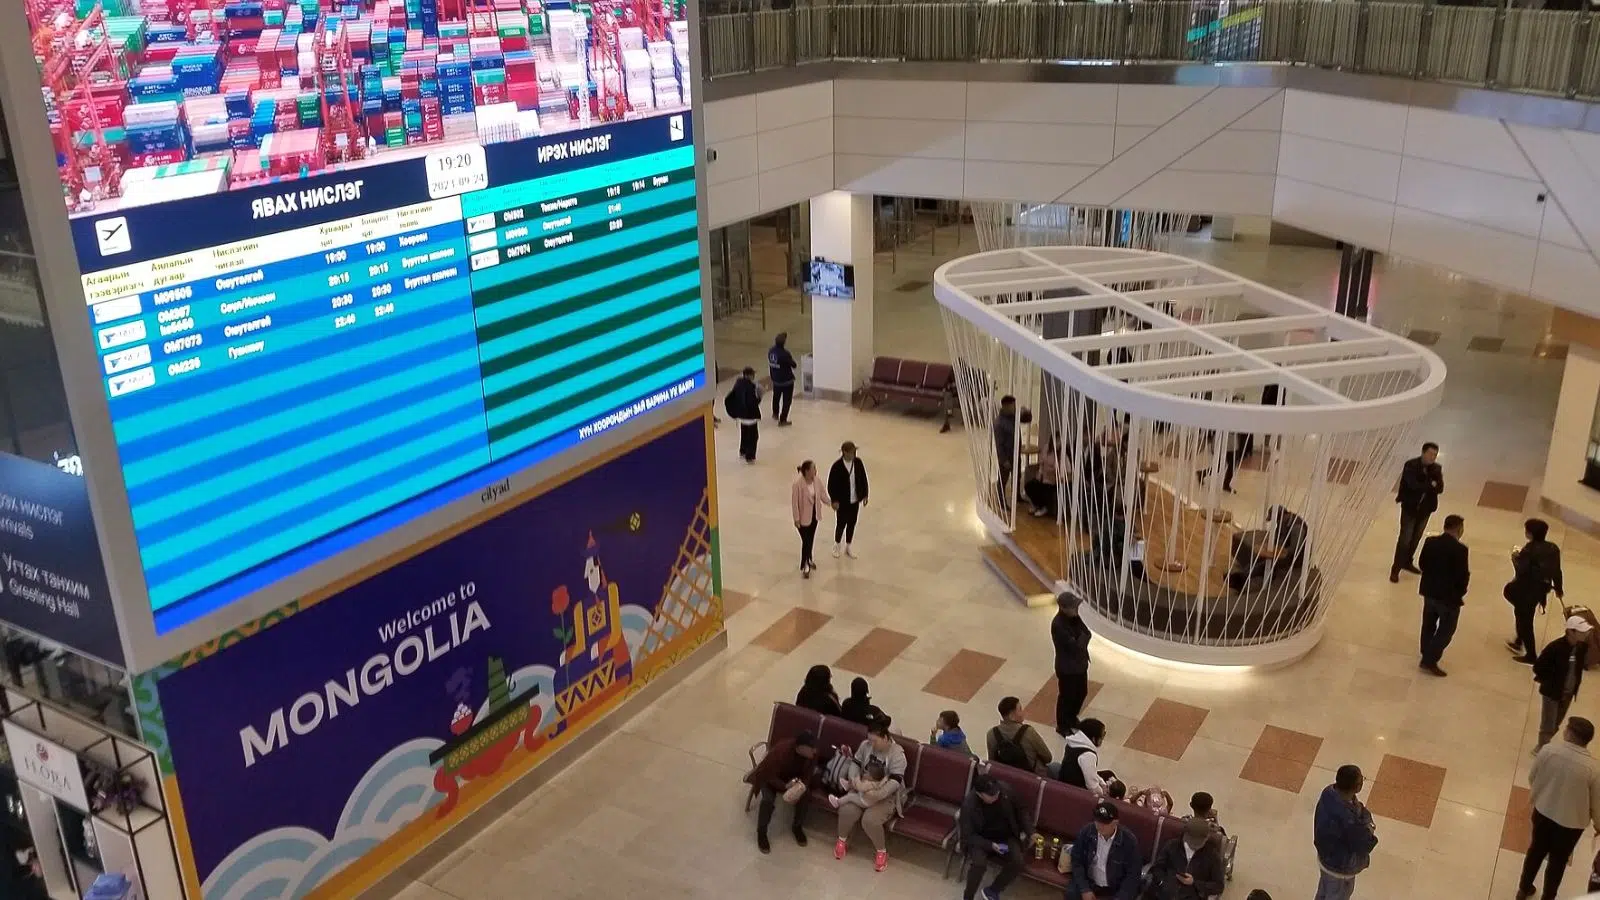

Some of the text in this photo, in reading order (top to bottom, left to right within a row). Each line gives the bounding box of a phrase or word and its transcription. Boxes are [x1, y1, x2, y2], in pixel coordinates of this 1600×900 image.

[437, 152, 472, 171] 19:20
[537, 134, 612, 164] ИРЭХ НИСЛЭГ
[251, 181, 364, 220] ЯВАХ НИСЛЭГ
[378, 580, 476, 643] Welcome to
[239, 599, 492, 768] MONGOLIA
